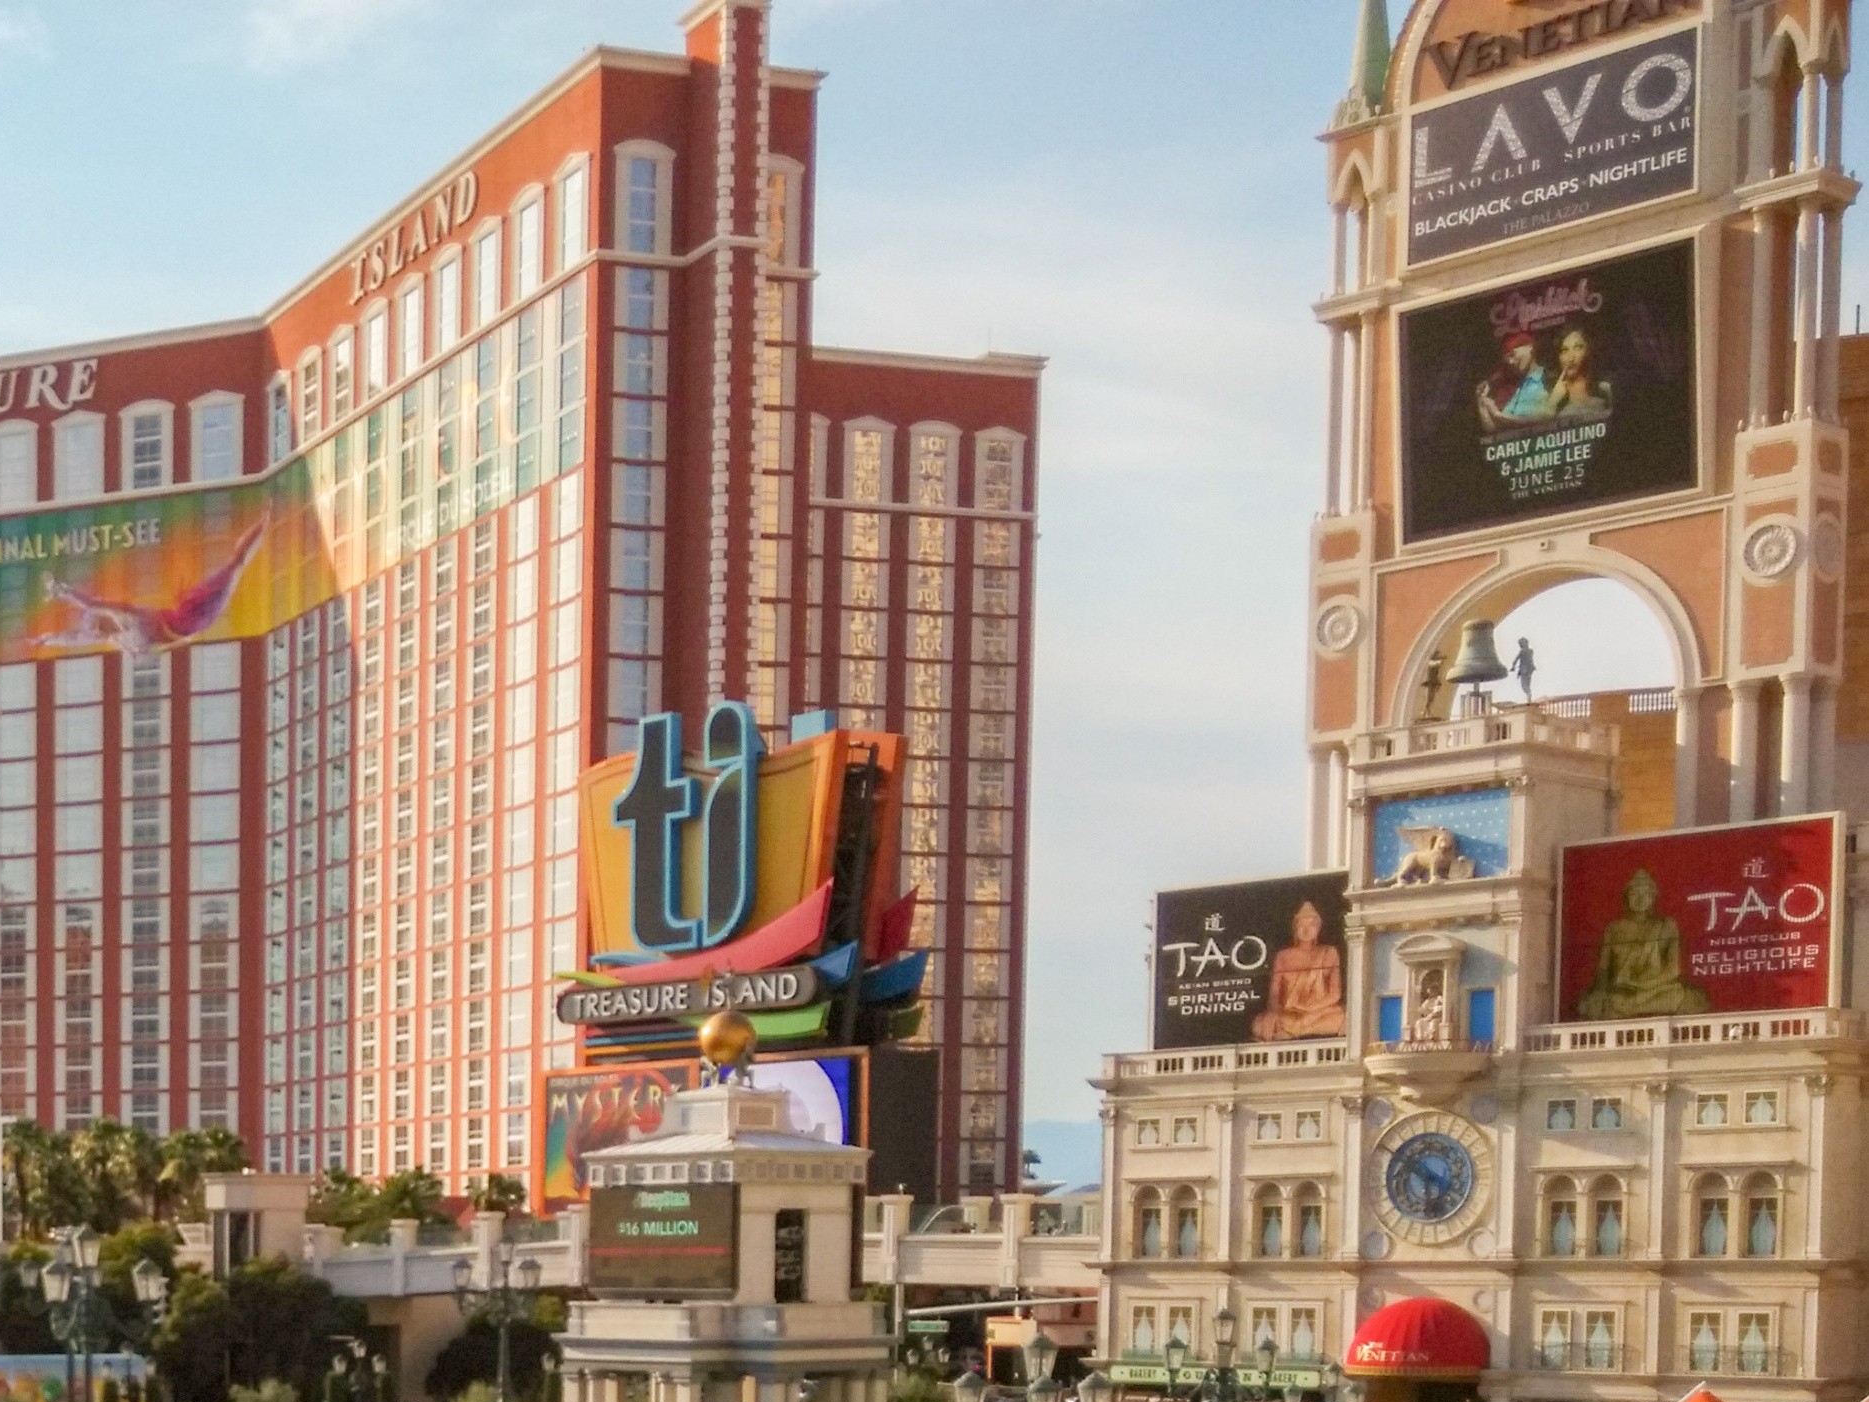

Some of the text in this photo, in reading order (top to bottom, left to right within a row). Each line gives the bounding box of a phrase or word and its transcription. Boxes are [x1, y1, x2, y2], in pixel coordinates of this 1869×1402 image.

[1414, 53, 1693, 188] LAVO
[1412, 116, 1692, 206] CASINO CLUB SPORTS BAR
[1414, 148, 1688, 236] BLACKJACK CRAPS NIGHTLIFE
[1501, 202, 1590, 235] THE PALAZZO
[349, 170, 479, 306] ISLAND
[1486, 438, 1531, 461] CARLY
[1535, 423, 1606, 451] AQUILINO
[1515, 450, 1562, 473] JAMIE
[1565, 444, 1592, 462] LEE
[1509, 463, 1585, 491] JUNE 25
[52, 518, 162, 557] MUST-SEE
[1687, 883, 1825, 931] TAO
[1162, 935, 1267, 977] TAO
[1692, 944, 1819, 964] RELIGIOUS
[1710, 931, 1801, 946] NIGHTCLUB
[1693, 957, 1816, 976] NIGHTLIFE
[574, 973, 798, 1020] TREASURE ISAND
[1167, 990, 1260, 1006] SPIRITUAL
[1181, 1001, 1245, 1015] DINING
[643, 1220, 699, 1236] MILLION
